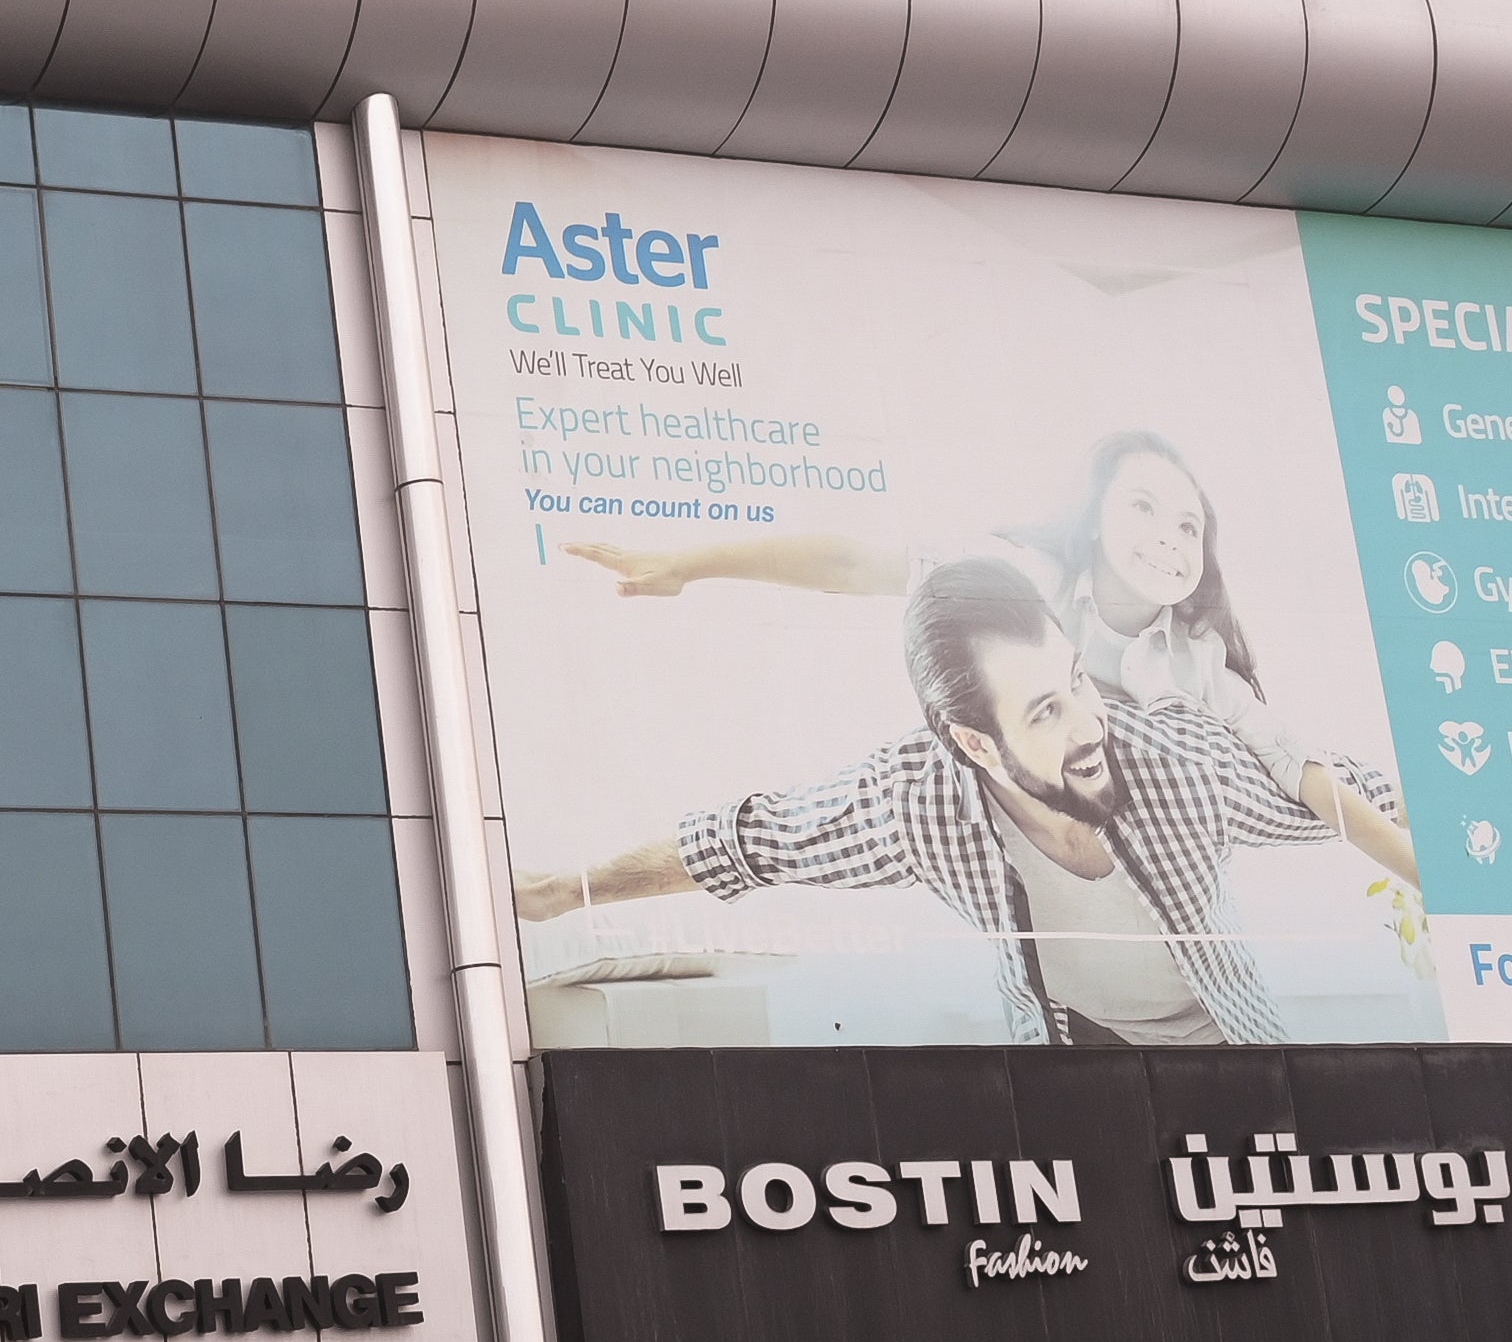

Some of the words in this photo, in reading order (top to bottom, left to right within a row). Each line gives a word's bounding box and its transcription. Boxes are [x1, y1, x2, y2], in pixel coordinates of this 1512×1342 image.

[500, 200, 720, 291] Aster
[505, 292, 729, 348] CLINIC
[572, 352, 636, 386] Treat
[639, 355, 686, 387] You
[691, 358, 744, 390] Well
[514, 396, 632, 444] Expert
[640, 401, 822, 449] healthcare
[519, 441, 553, 477] in
[562, 447, 641, 488] your
[652, 449, 888, 496] neighborhood
[523, 487, 572, 517] You
[576, 493, 626, 517] can
[630, 493, 703, 522] count
[706, 497, 740, 522] on
[744, 500, 776, 525] us
[223, 1130, 410, 1213] رضا
[653, 1158, 1084, 1235] BOSTIN
[1166, 1130, 1512, 1230] بوستين
[57, 1269, 427, 1339] EXCHANGE
